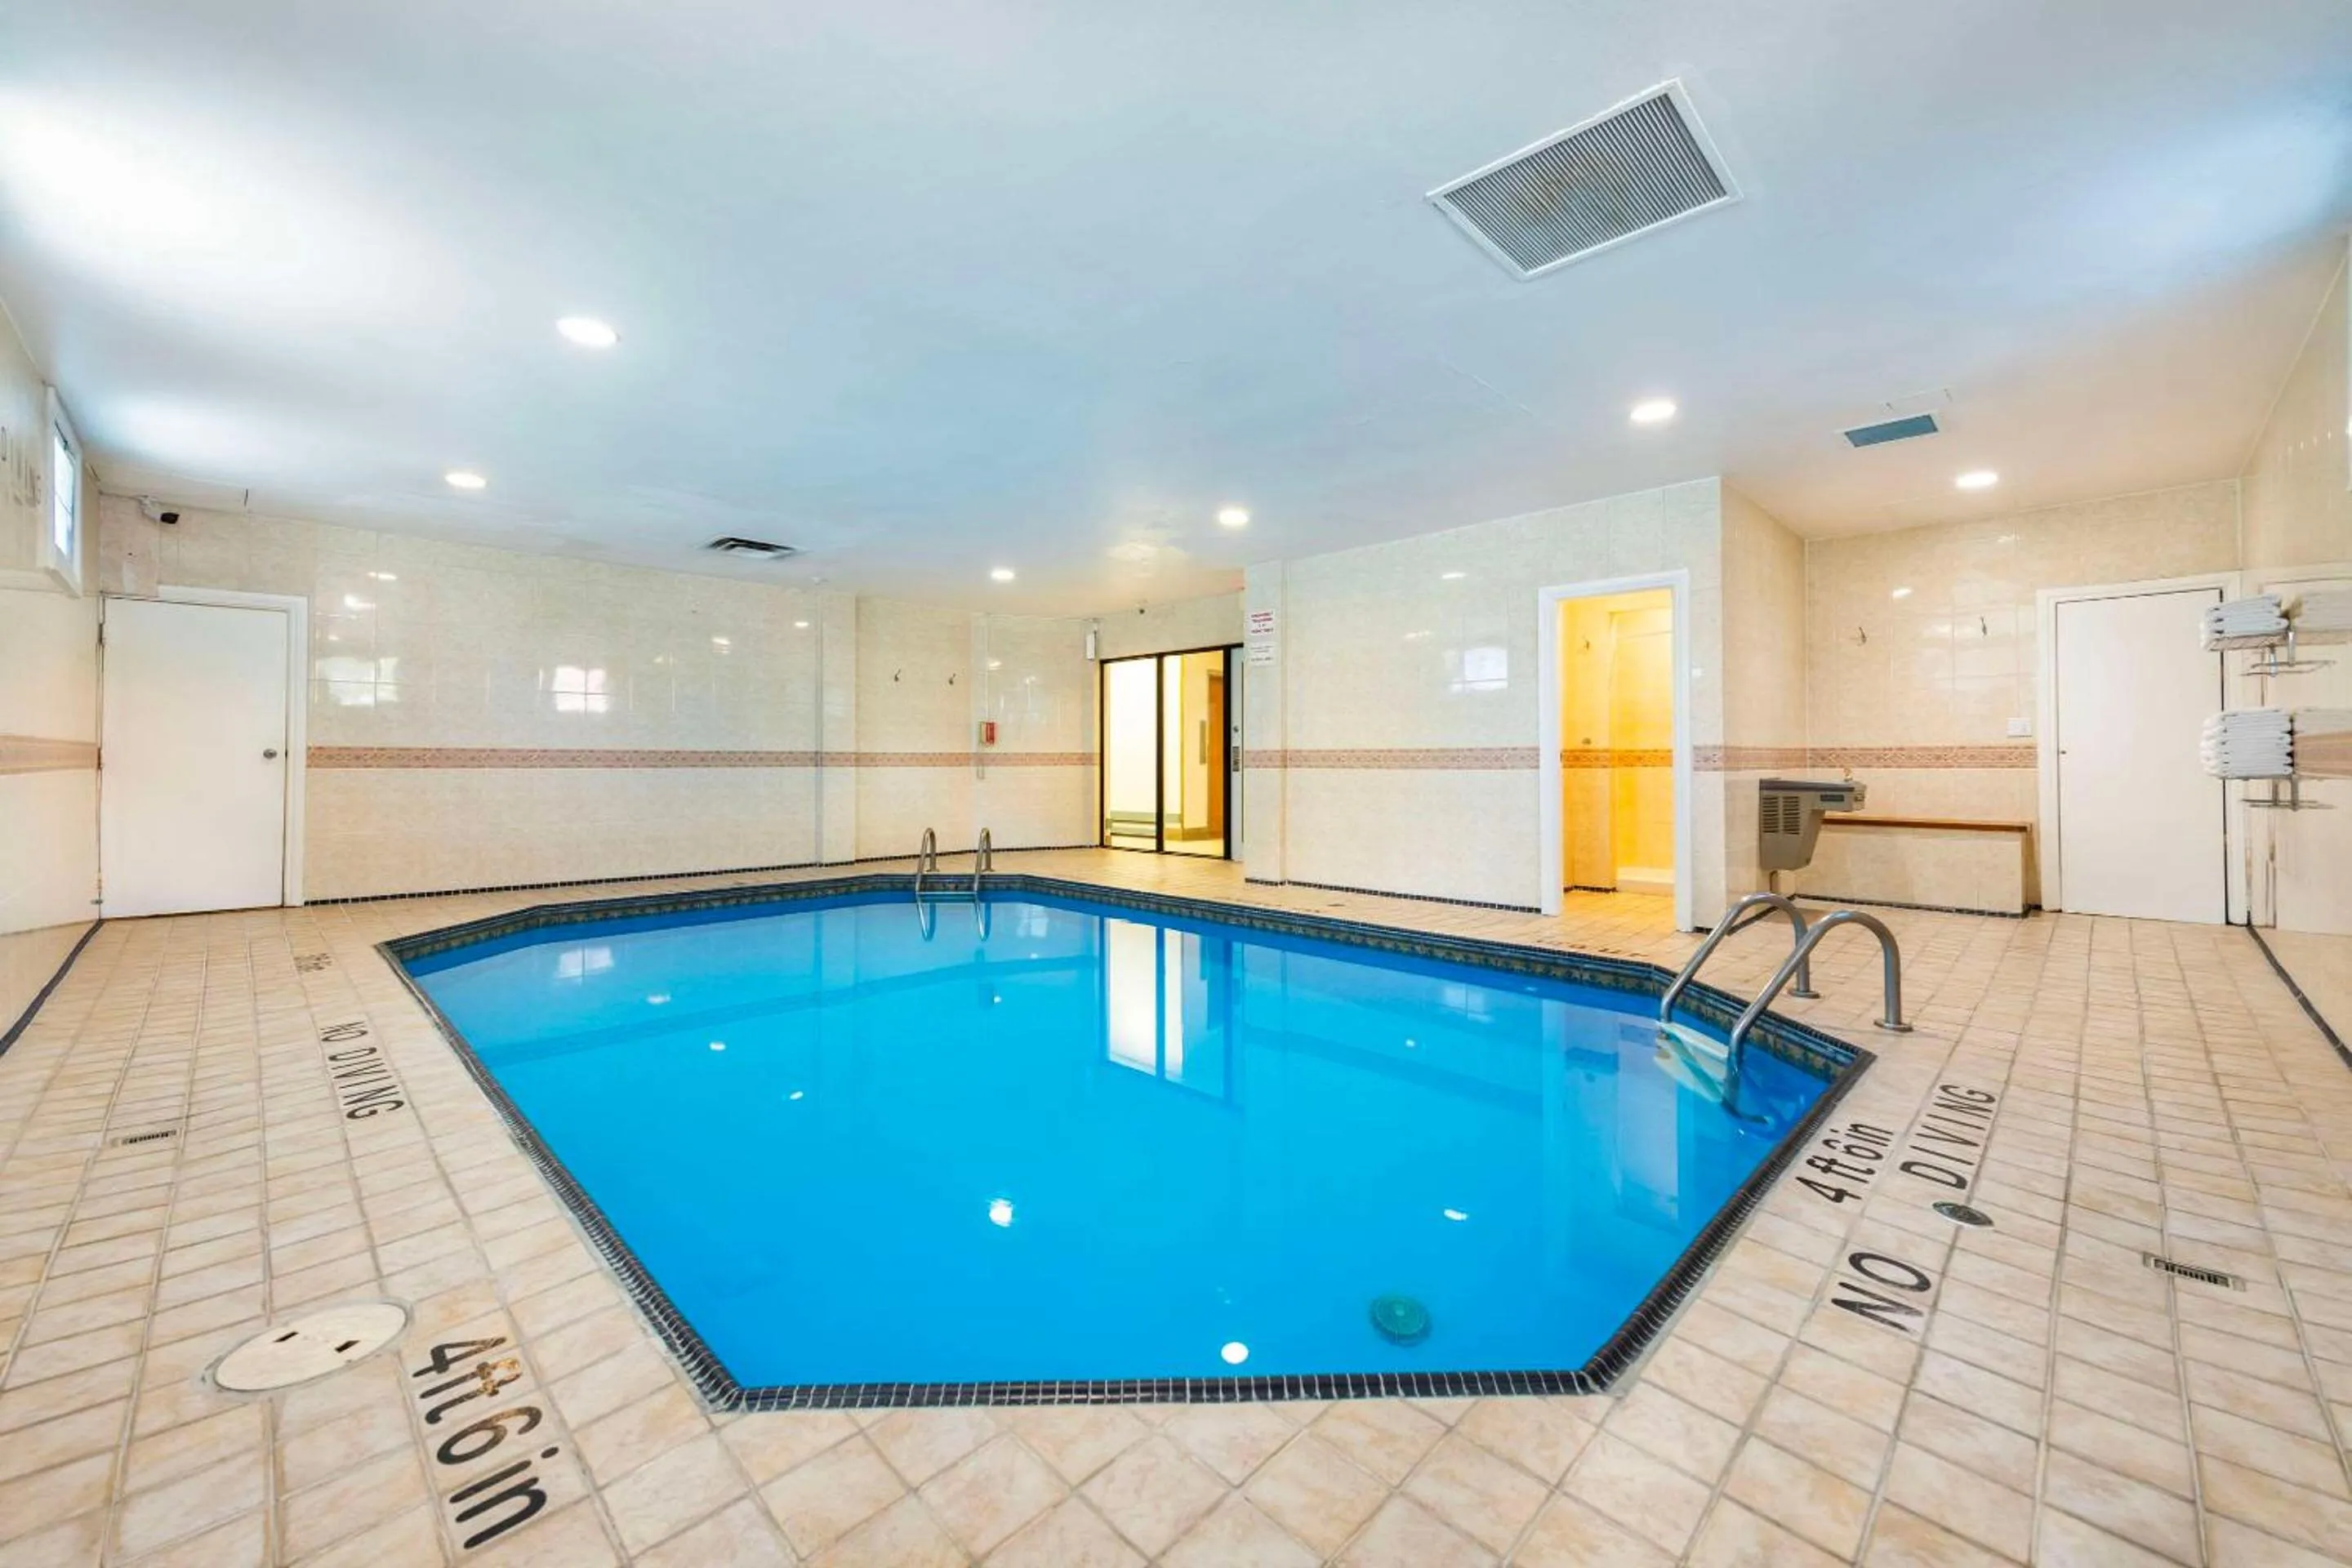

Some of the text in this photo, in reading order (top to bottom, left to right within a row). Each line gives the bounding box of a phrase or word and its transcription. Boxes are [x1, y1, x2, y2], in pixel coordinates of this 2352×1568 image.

[320, 1021, 404, 1120] NO DIVING
[1831, 1084, 1996, 1336] NO DIVING
